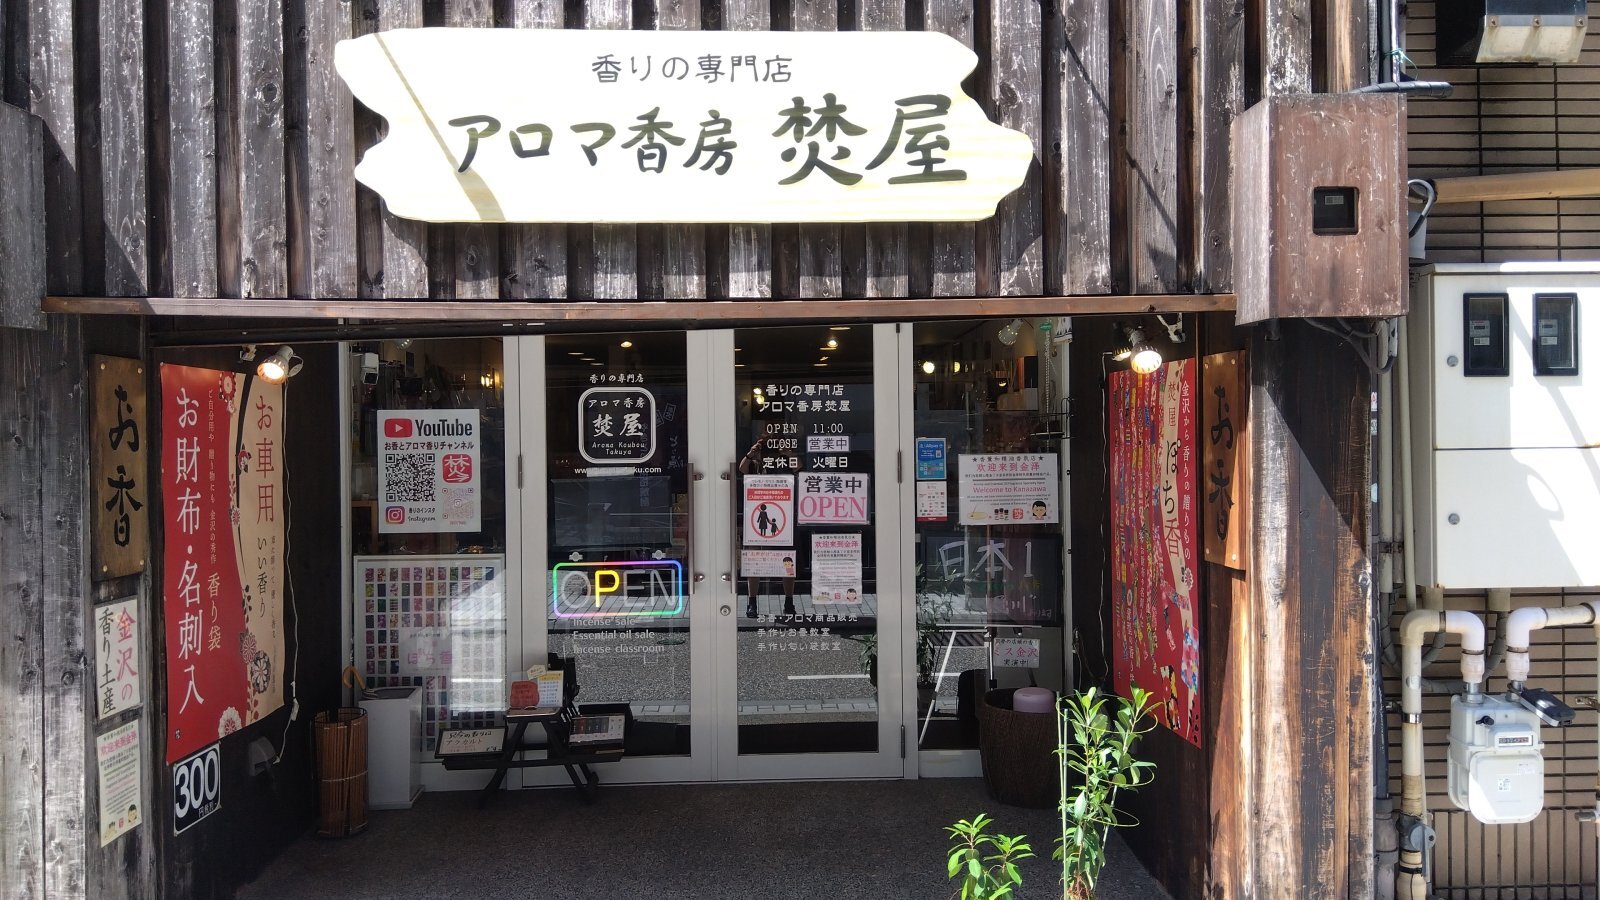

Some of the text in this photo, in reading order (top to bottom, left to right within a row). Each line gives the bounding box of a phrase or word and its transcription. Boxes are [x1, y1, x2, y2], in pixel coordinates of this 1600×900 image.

[592, 54, 792, 84] 香りの専門店
[448, 93, 968, 185] アロマ香房 焚屋
[589, 373, 644, 384] 香りの専門店
[766, 384, 844, 396] 香りの専門店
[588, 397, 645, 408] アロマ香房
[415, 418, 473, 437] YouTube
[592, 413, 644, 437] 焚屋
[766, 423, 844, 434] OPEN 11:00
[384, 441, 474, 451] お香とアロマ香りチャンネル
[766, 438, 798, 449] CLOSE
[808, 437, 848, 451] 営業中
[105, 385, 143, 547] お香
[256, 396, 275, 525] お車用
[762, 456, 848, 468] 定休日 火曜日
[1163, 381, 1182, 558] 焚屋 ぽち香
[1208, 384, 1235, 542] お香
[804, 475, 863, 494] 営業中
[799, 495, 866, 518] OPEN
[175, 387, 204, 714] お財布・名刺入
[256, 536, 268, 618] いい香り
[560, 569, 676, 609] OPEN
[207, 572, 221, 651] 香り袋
[573, 617, 636, 626] Incense sale
[573, 629, 655, 640] Essential oil sale
[116, 606, 138, 701] 金沢の
[573, 643, 665, 654] Incense classroom
[98, 607, 116, 714] 香り土産
[176, 750, 218, 818] 300
